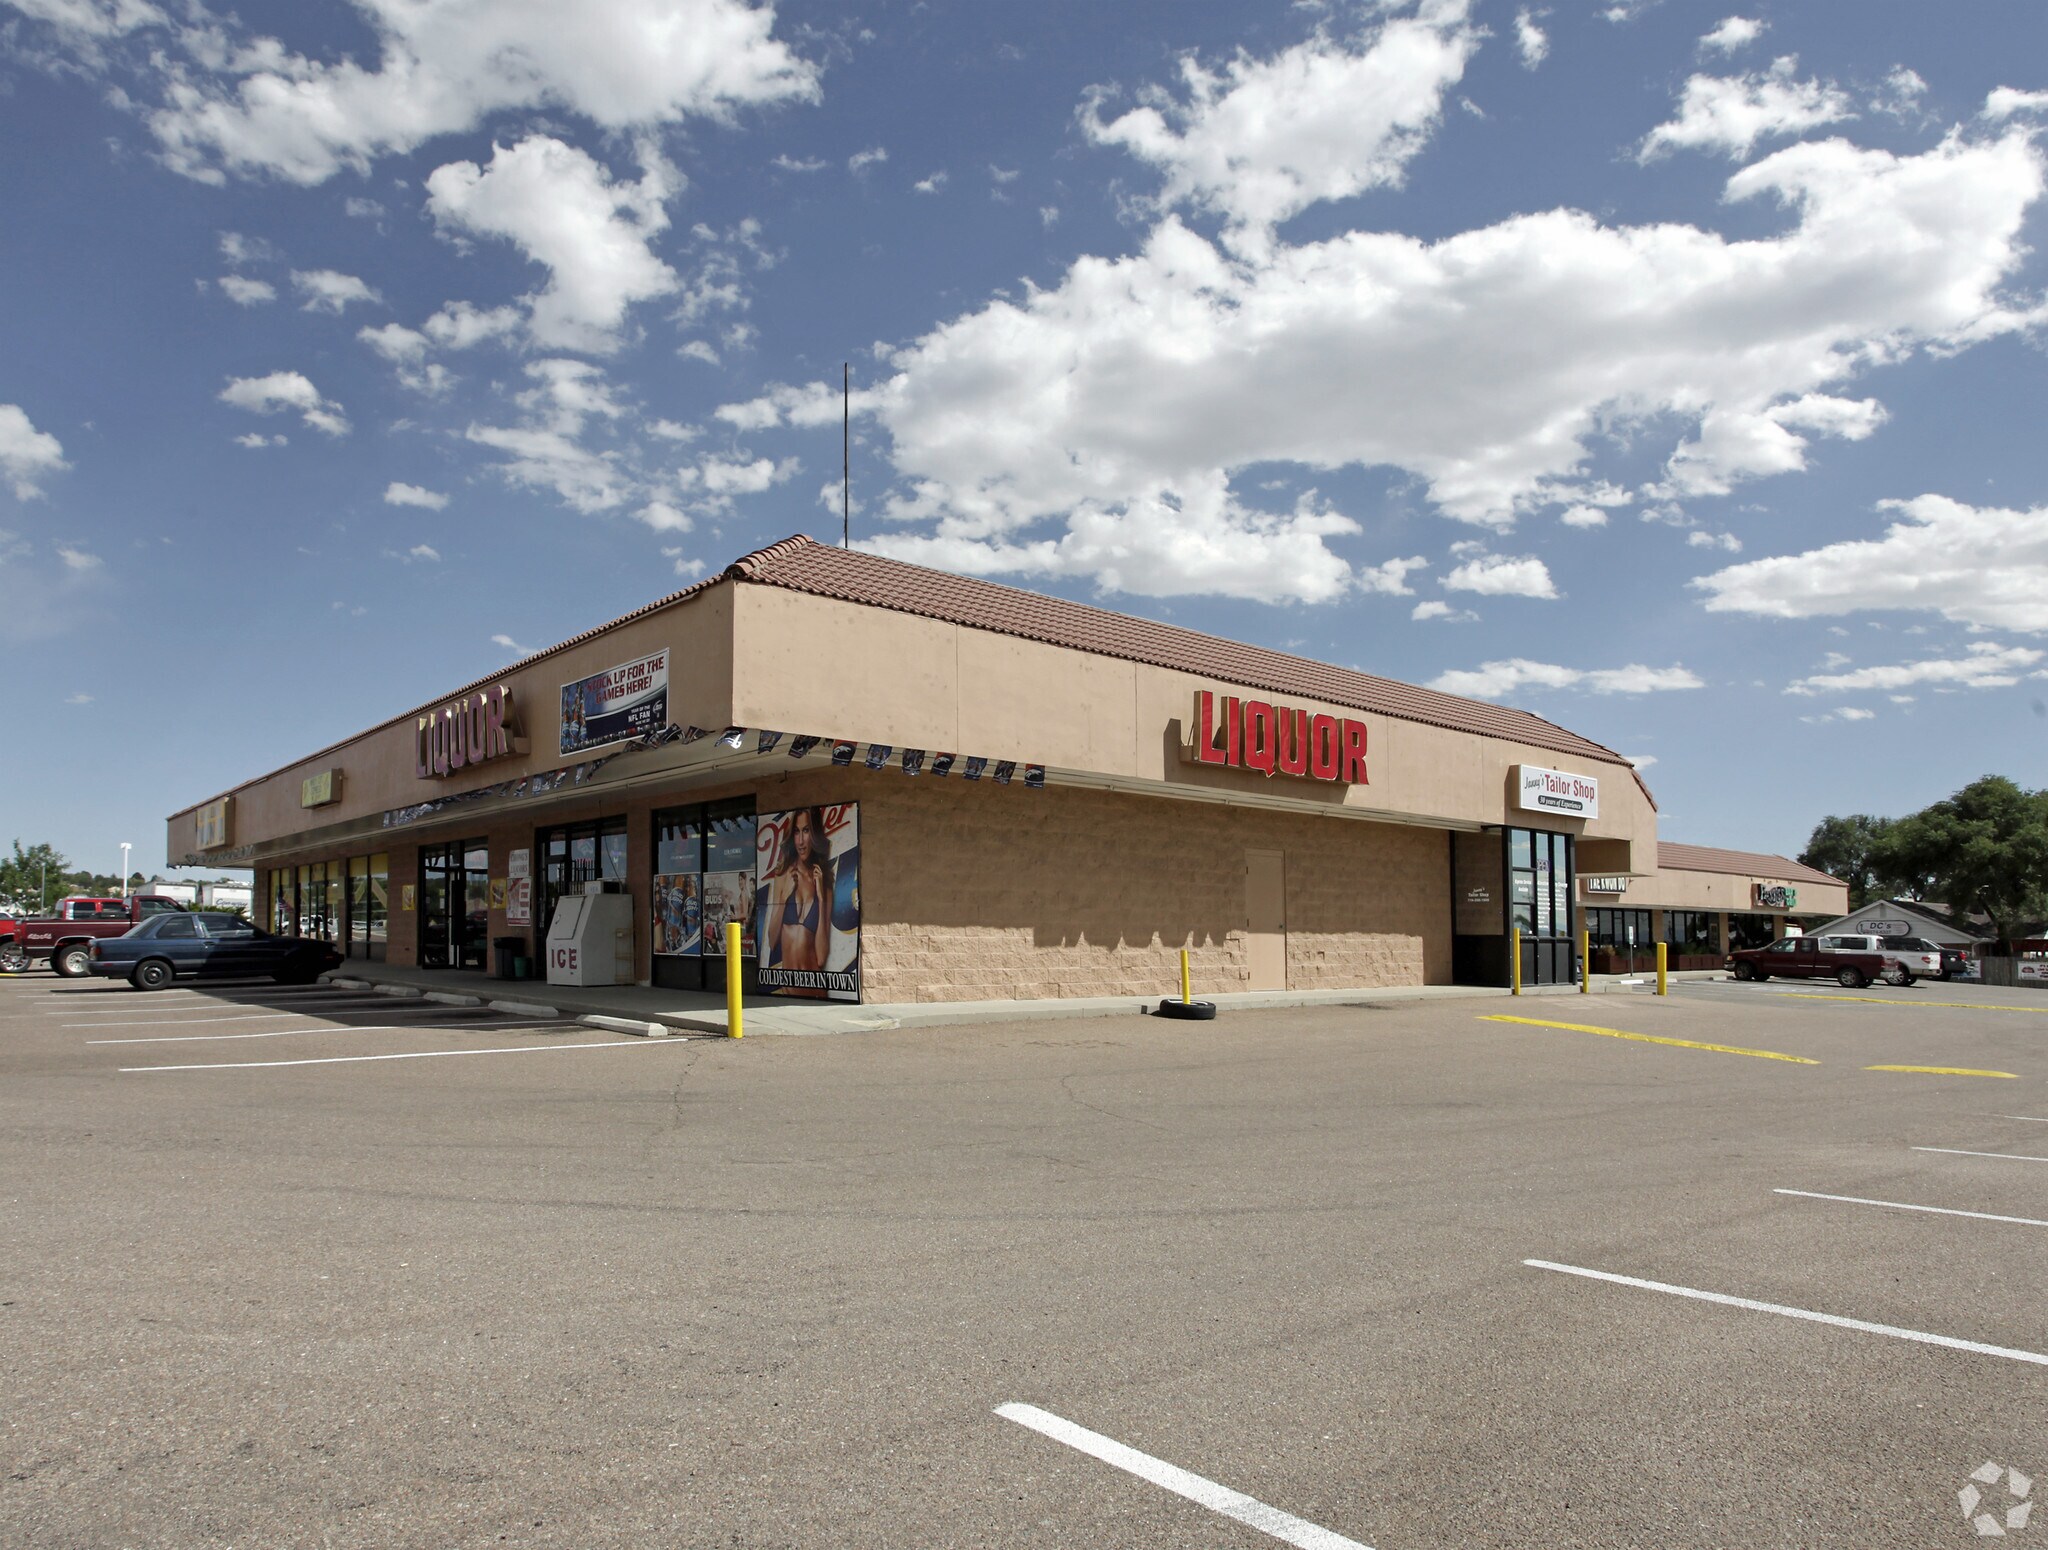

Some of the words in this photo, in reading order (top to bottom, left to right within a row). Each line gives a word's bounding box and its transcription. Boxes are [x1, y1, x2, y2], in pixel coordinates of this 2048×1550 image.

[587, 673, 613, 691] STOCK
[614, 669, 626, 683] UP
[628, 664, 645, 680] FOR
[647, 656, 664, 672] THE
[596, 686, 625, 704] GAMES
[627, 676, 652, 694] HERE!
[628, 714, 638, 723] NFL
[640, 710, 651, 719] FAN
[415, 684, 508, 778] LIQUOR
[1199, 690, 1370, 785] LIQUOR
[1545, 774, 1571, 795] Tailor
[1573, 779, 1595, 803] Shop
[1546, 798, 1556, 806] years
[1561, 800, 1582, 810] Experience
[705, 895, 723, 905] BUDS
[1869, 922, 1892, 930] DC's
[551, 948, 578, 970] ICE
[758, 968, 794, 987] COLDEST
[794, 969, 816, 989] BEER
[816, 971, 827, 989] IN
[827, 972, 856, 991] TOWN
